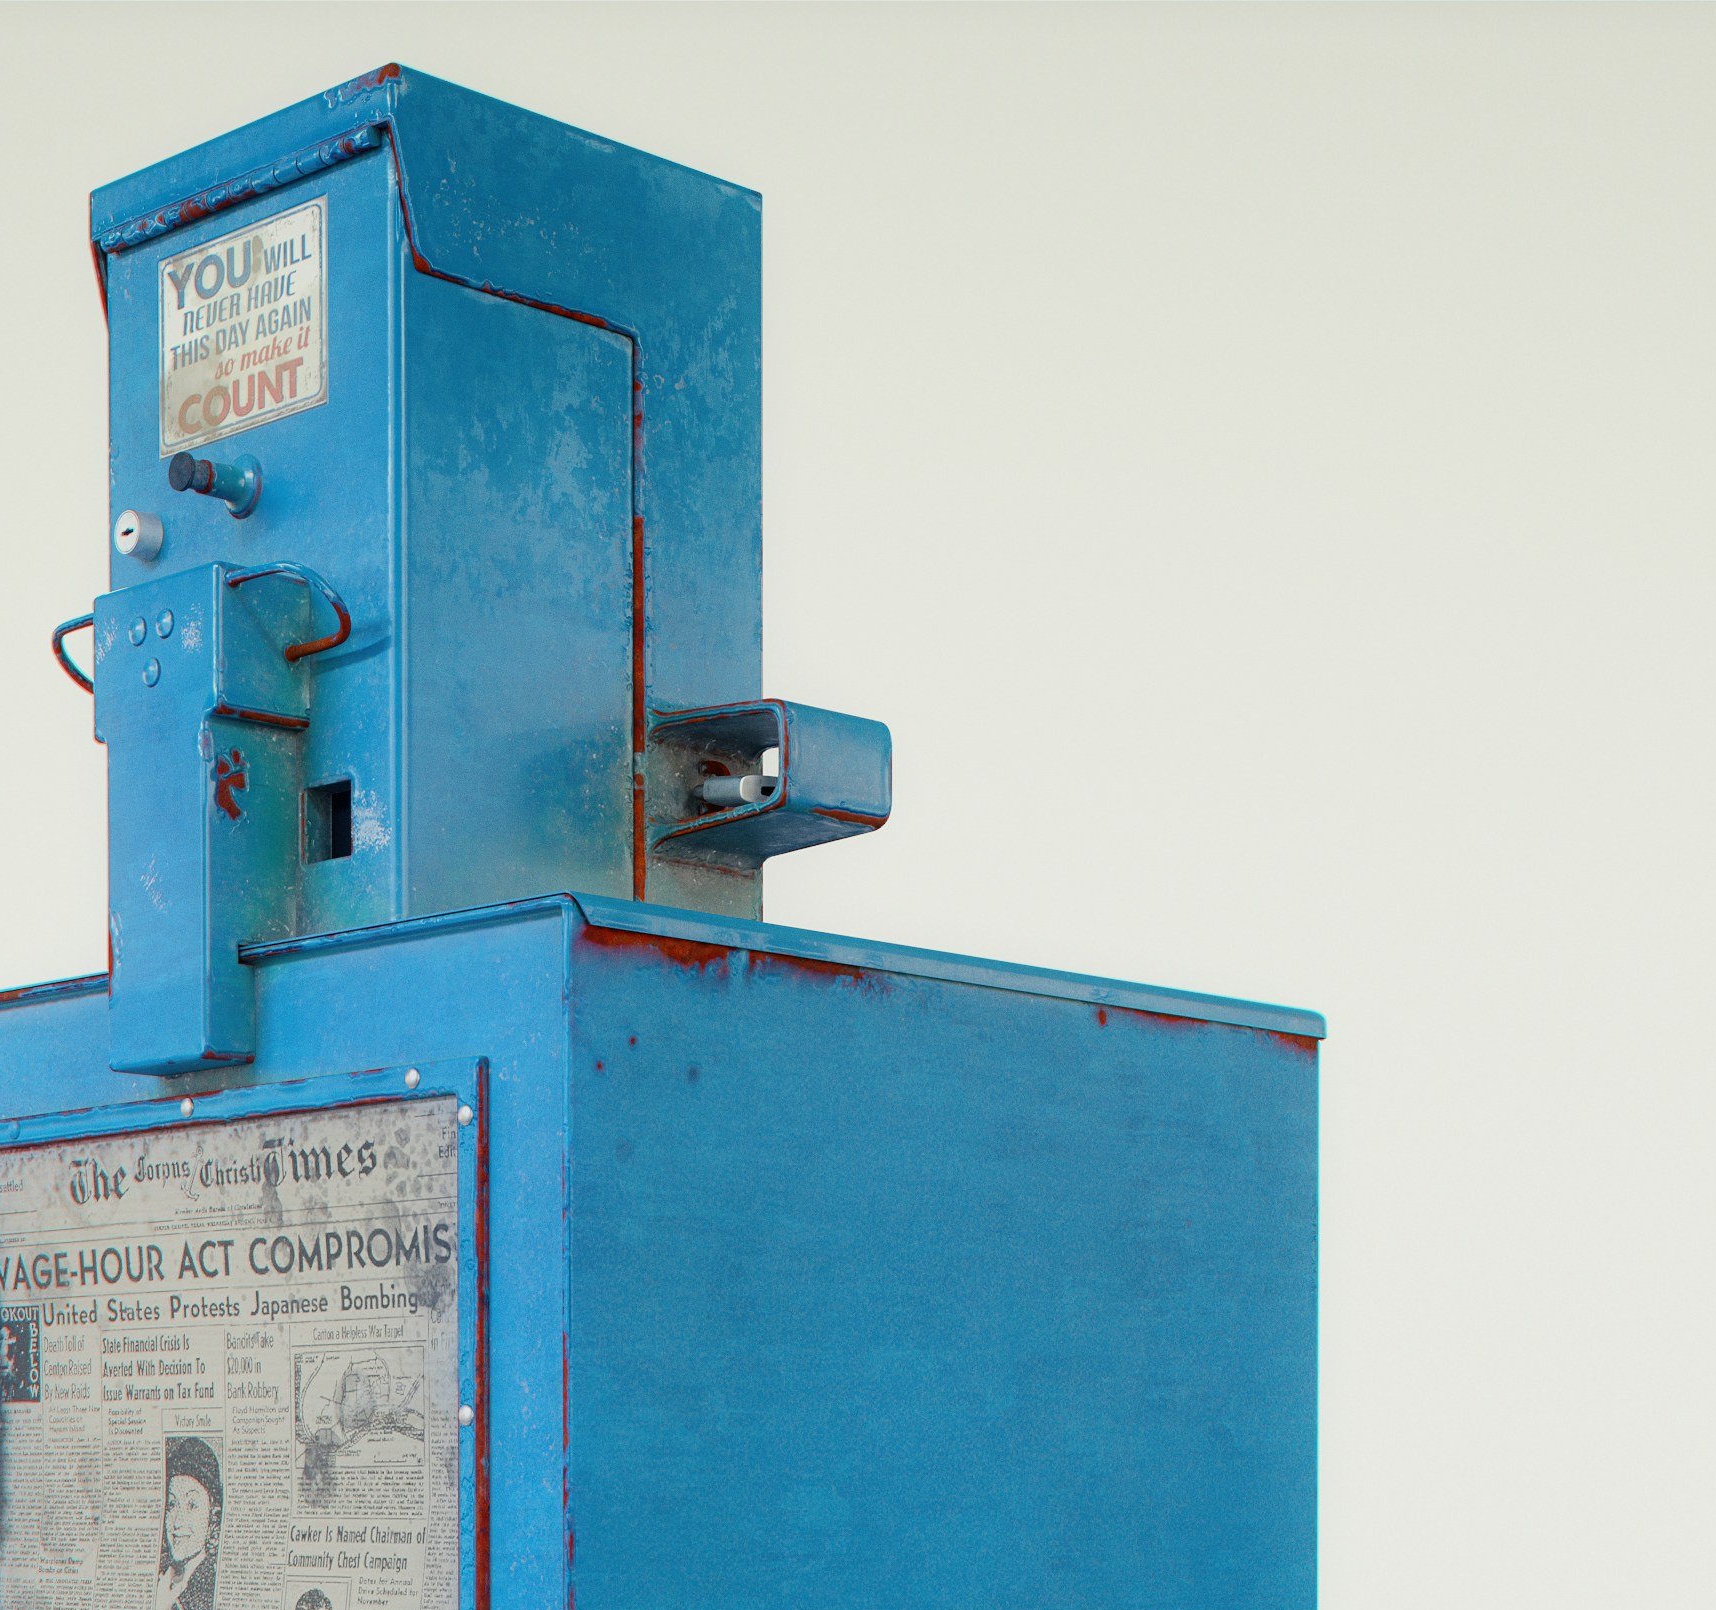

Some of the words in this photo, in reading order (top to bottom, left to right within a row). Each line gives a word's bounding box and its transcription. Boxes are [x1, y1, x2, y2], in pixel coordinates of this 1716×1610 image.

[167, 239, 251, 310] YOU
[263, 234, 312, 274] WILL
[183, 293, 241, 336] NEVER
[246, 271, 297, 312] HAVE
[170, 334, 210, 370] THIS
[216, 319, 250, 354] DAY
[255, 296, 312, 341] AGAIN
[215, 359, 234, 380] so
[240, 334, 292, 371] make
[297, 326, 311, 350] it
[177, 357, 304, 435] COUNT
[68, 1155, 129, 1205] The
[134, 1153, 191, 1188] Corpus
[199, 1156, 262, 1189] Christi
[262, 1136, 378, 1188] Times
[178, 1239, 234, 1280] ACT
[249, 1222, 457, 1275] COMPROMIS
[42, 1299, 97, 1327] United
[107, 1297, 160, 1322] States
[170, 1294, 240, 1320] Protests
[251, 1290, 328, 1321] Japanese
[340, 1283, 418, 1314] Bombing
[226, 1332, 254, 1350] Bandits
[255, 1331, 274, 1348] Take
[313, 1328, 334, 1341] Canton
[335, 1330, 340, 1340] a
[341, 1326, 368, 1340] Helpless
[369, 1325, 382, 1339] War
[383, 1324, 404, 1339] Target
[44, 1336, 63, 1353] Death
[64, 1335, 77, 1352] Toll
[78, 1334, 85, 1350] of
[102, 1336, 121, 1354] State
[123, 1334, 158, 1353] Financial
[160, 1334, 181, 1351] Crisis
[183, 1333, 190, 1350] Is
[29, 1322, 39, 1398] BELOW
[44, 1359, 67, 1376] Canton
[68, 1357, 91, 1375] Raised
[102, 1359, 133, 1378] Averted
[137, 1358, 155, 1376] With
[159, 1357, 193, 1376] Decision
[196, 1357, 206, 1374] To
[254, 1357, 262, 1374] in
[45, 1386, 54, 1402] By
[54, 1384, 70, 1400] New
[71, 1383, 91, 1399] Raids
[103, 1384, 123, 1401] Issue
[125, 1383, 161, 1401] Warrants
[164, 1386, 175, 1400] on
[177, 1382, 192, 1399] Tax
[195, 1381, 214, 1399] Fund
[227, 1382, 246, 1399] Bank
[248, 1381, 280, 1401] Robbery
[174, 1414, 194, 1428] Victory
[196, 1413, 212, 1427] Smile
[290, 1525, 322, 1543] Cawker
[325, 1525, 333, 1542] Is
[336, 1525, 366, 1544] Named
[370, 1526, 412, 1545] Chairman
[416, 1526, 427, 1545] of
[288, 1551, 334, 1571] Community
[337, 1551, 361, 1569] Chest
[363, 1551, 408, 1573] Campaign
[376, 1586, 407, 1596] Scheduled
